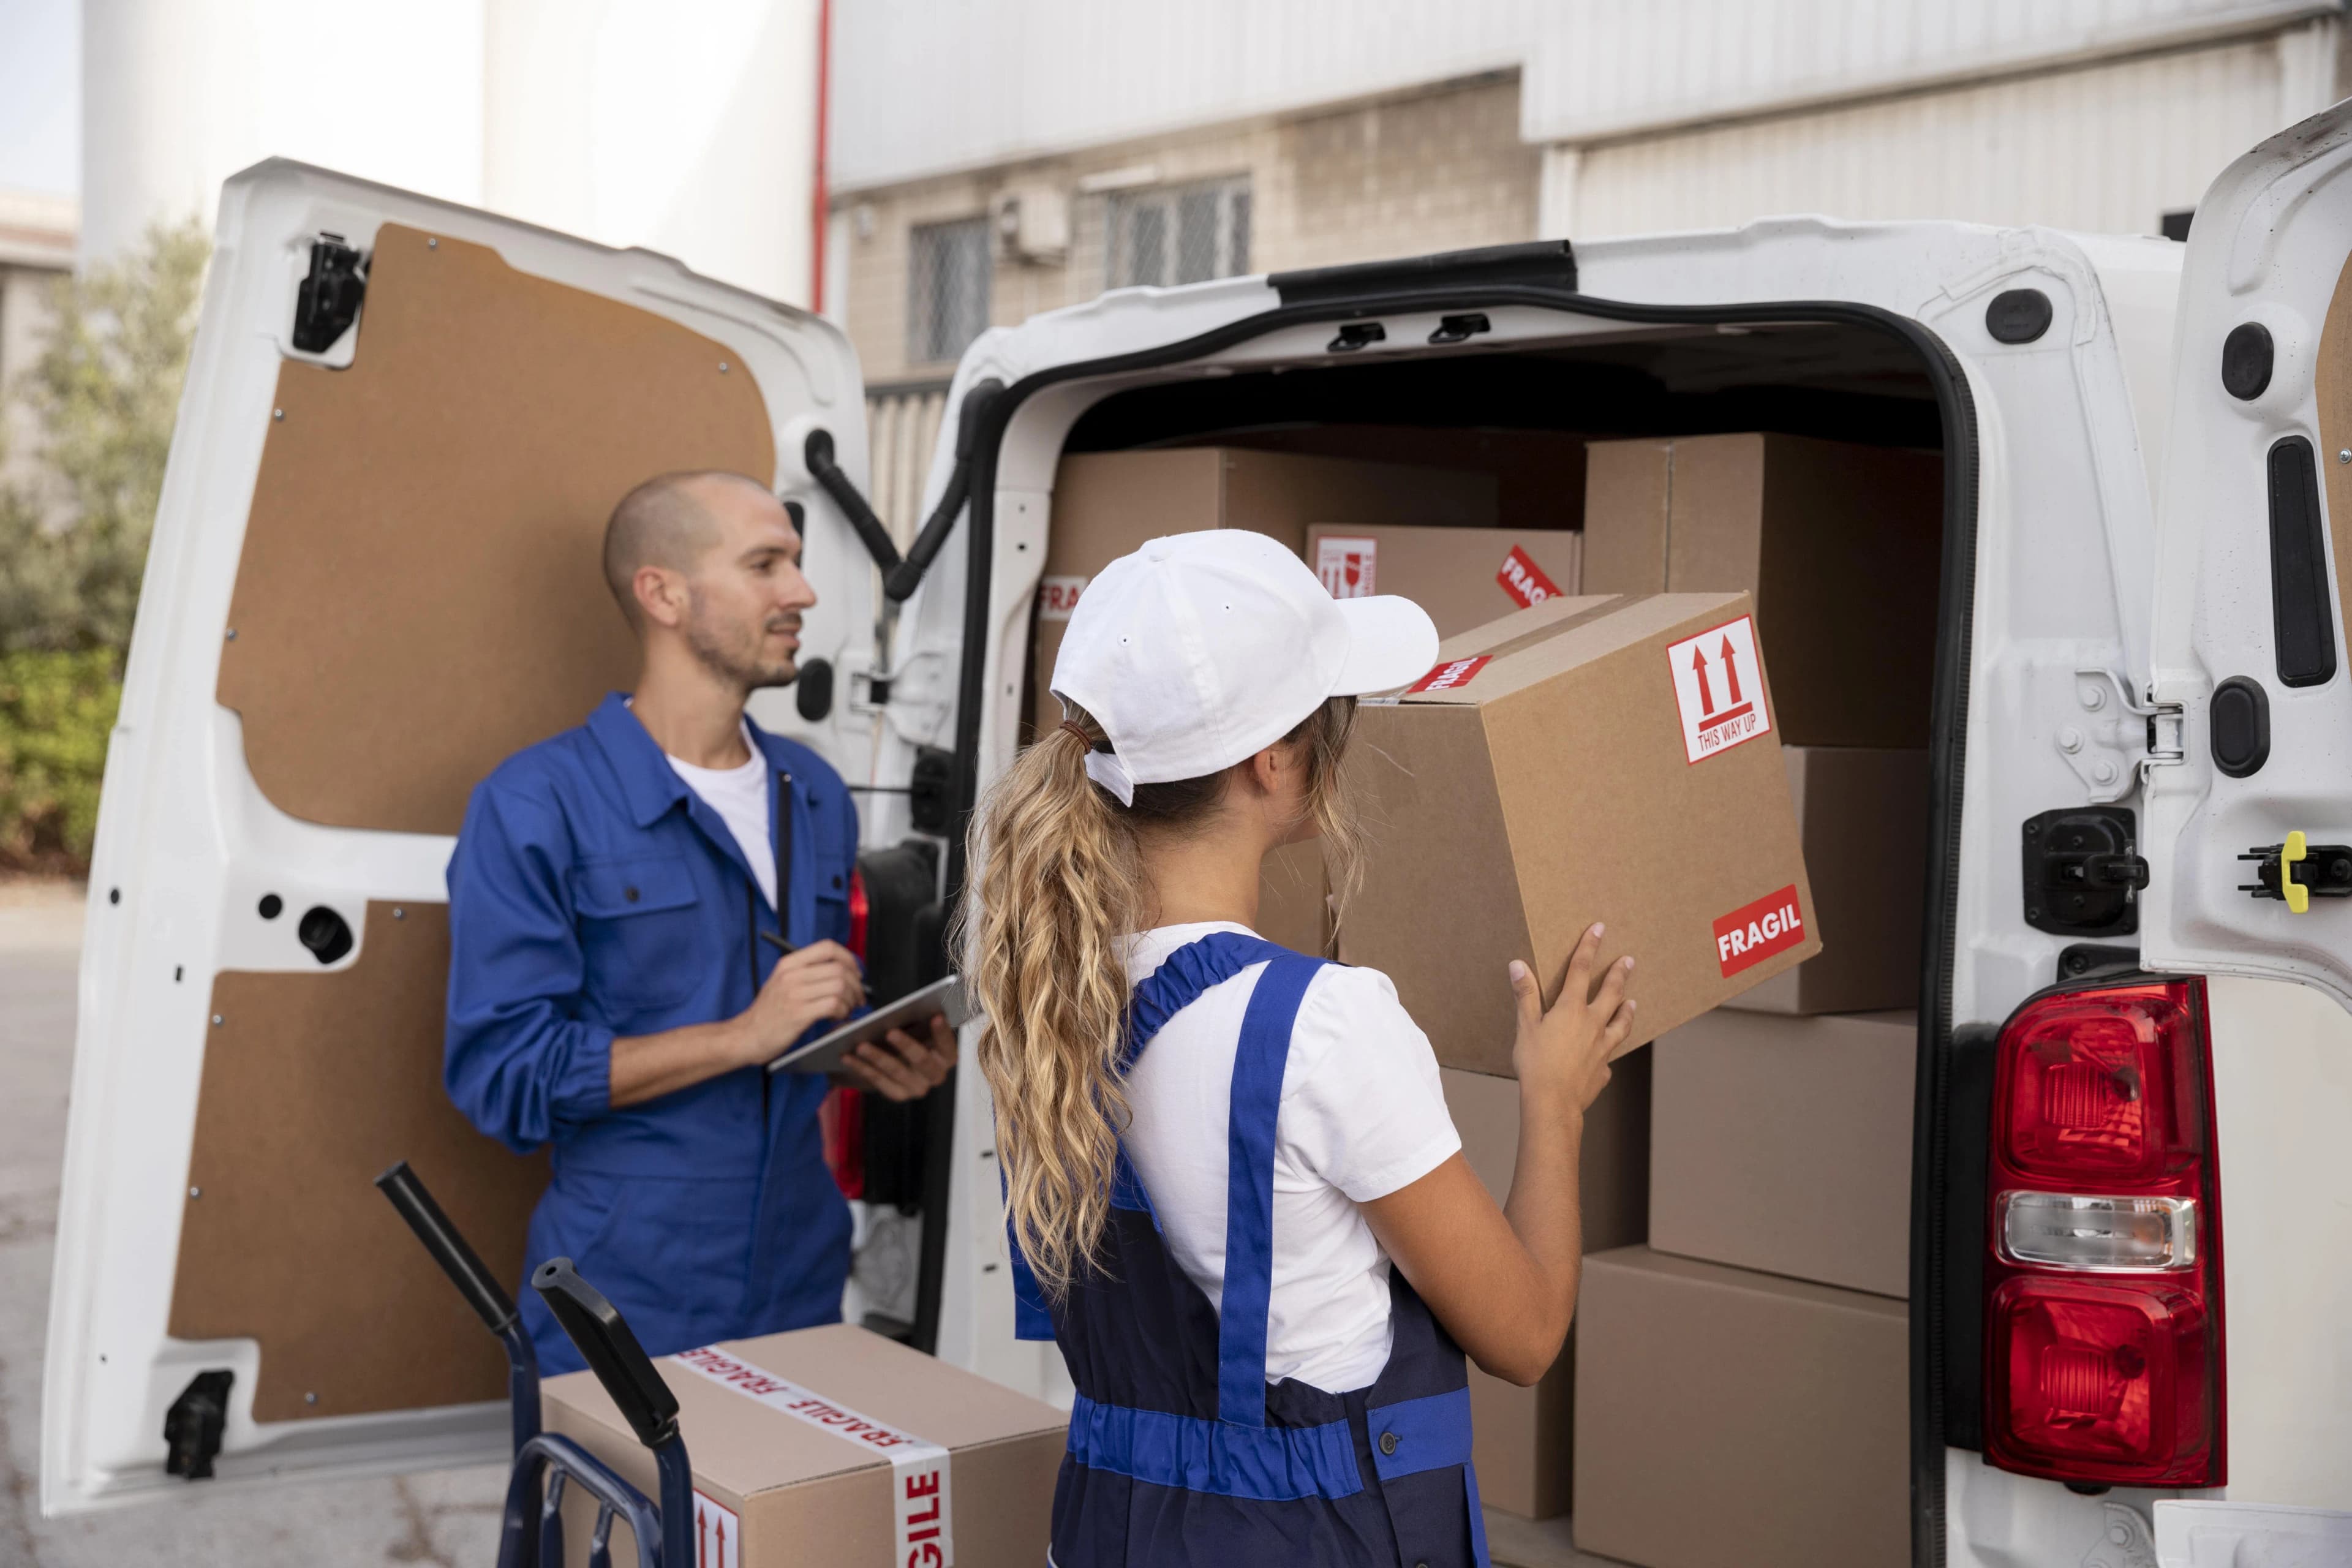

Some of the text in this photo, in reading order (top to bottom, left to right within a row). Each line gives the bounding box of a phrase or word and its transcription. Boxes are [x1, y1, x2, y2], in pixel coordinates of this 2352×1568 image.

[1502, 555, 1549, 606] FRAG
[1424, 657, 1478, 691] FRAGIL
[1698, 714, 1756, 751] THIS WAY UP
[1717, 903, 1801, 962] FRAGIL
[677, 1348, 788, 1394] FRAGILE
[786, 1400, 913, 1447] FRAGILE
[907, 1471, 942, 1568] GILE
